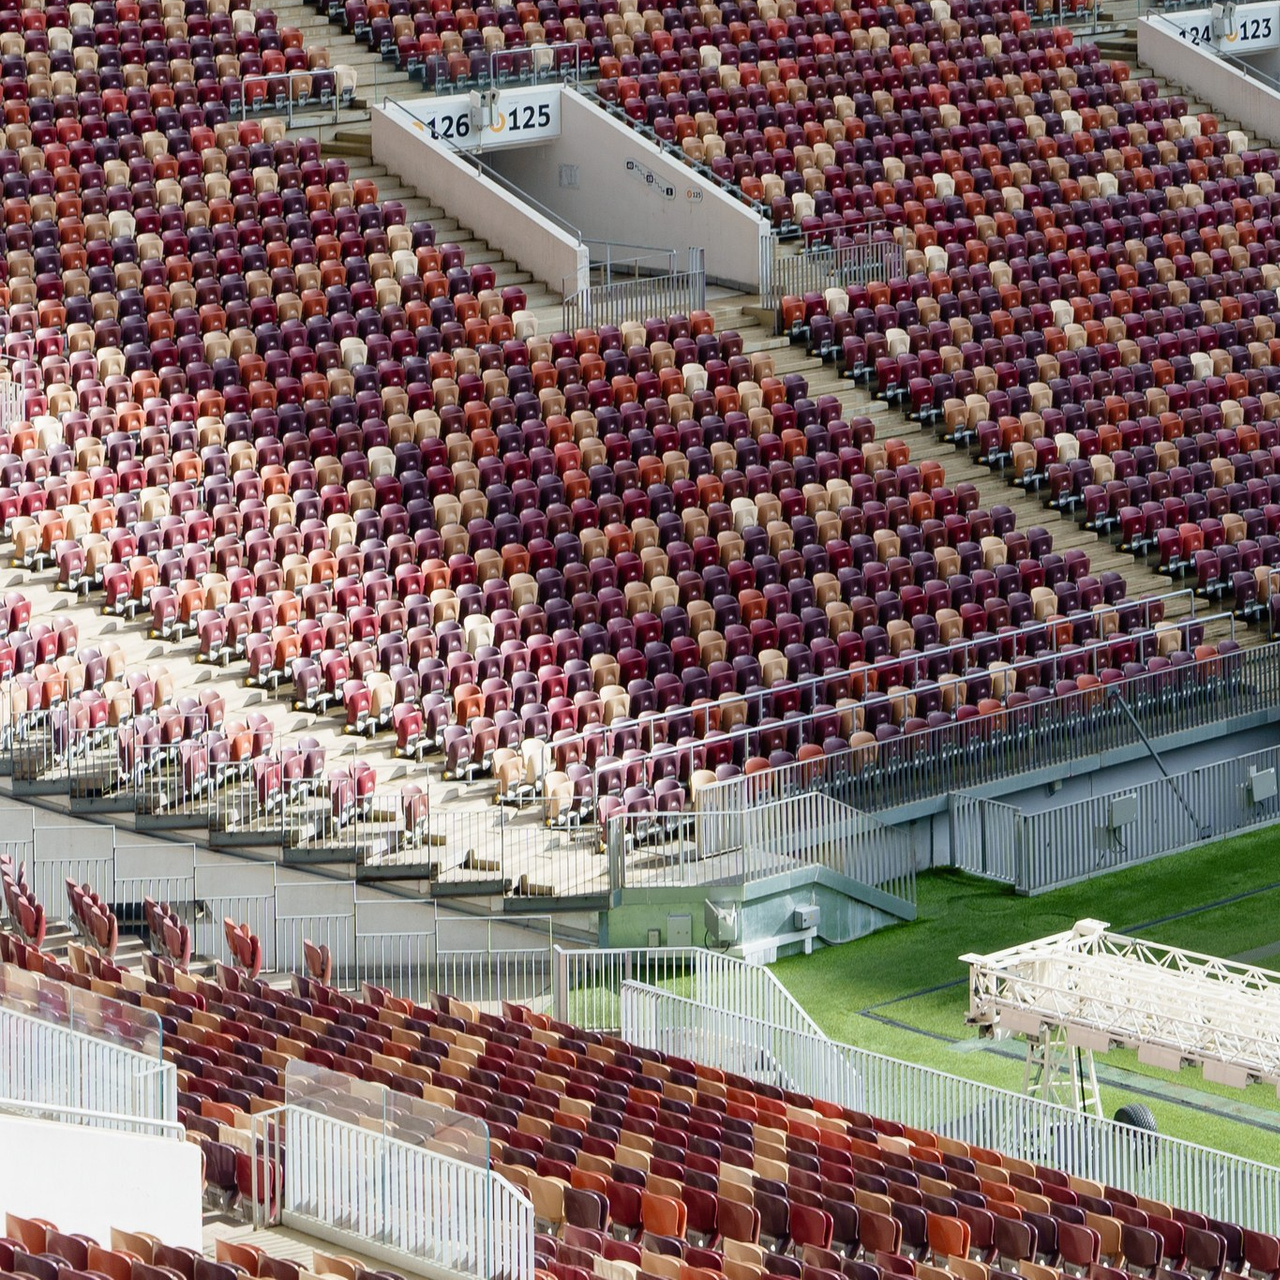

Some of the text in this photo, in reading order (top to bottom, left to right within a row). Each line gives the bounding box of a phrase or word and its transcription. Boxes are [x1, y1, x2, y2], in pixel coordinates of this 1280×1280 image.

[1240, 17, 1272, 41] 123
[427, 113, 470, 140] 126
[508, 104, 551, 131] 125
